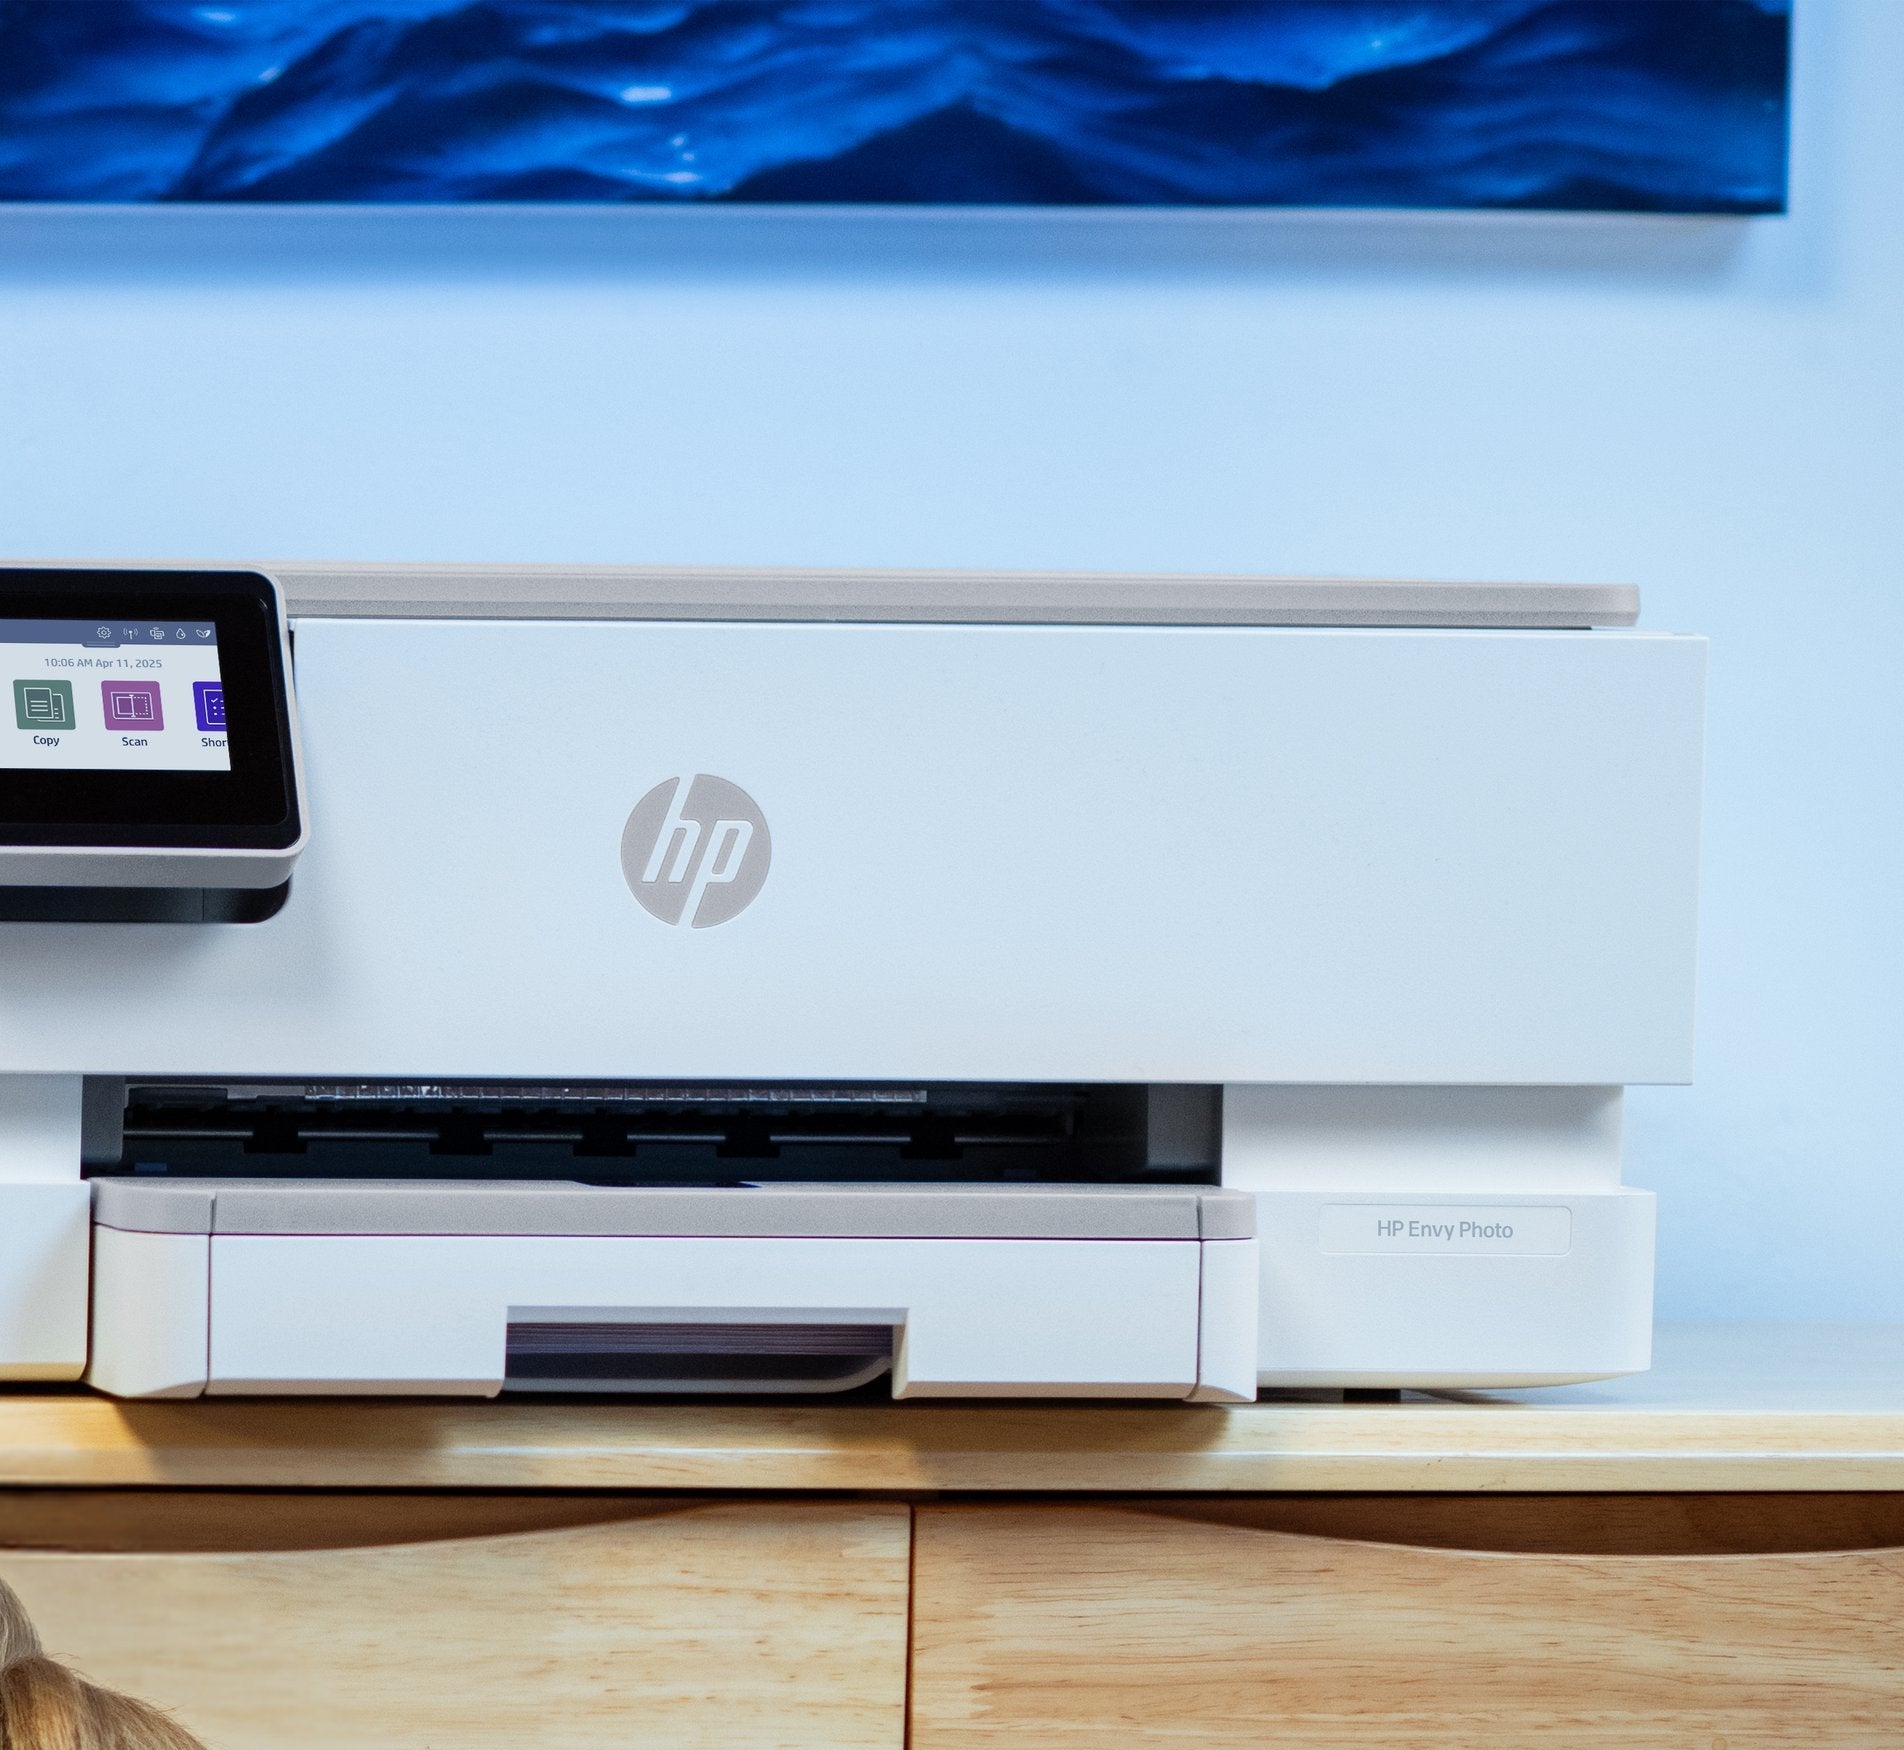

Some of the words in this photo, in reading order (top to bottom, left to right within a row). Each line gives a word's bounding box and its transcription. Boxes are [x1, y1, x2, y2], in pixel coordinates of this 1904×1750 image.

[44, 658, 75, 667] 10:06
[77, 658, 94, 668] AM
[95, 659, 114, 669] Apr
[116, 659, 133, 669] 11,
[135, 659, 162, 668] 2025
[33, 735, 60, 747] Copy
[121, 737, 148, 747] Scan
[639, 773, 756, 928] hp
[1377, 1220, 1404, 1237] HP
[1408, 1220, 1455, 1241] Envy
[1459, 1221, 1514, 1239] Photo
